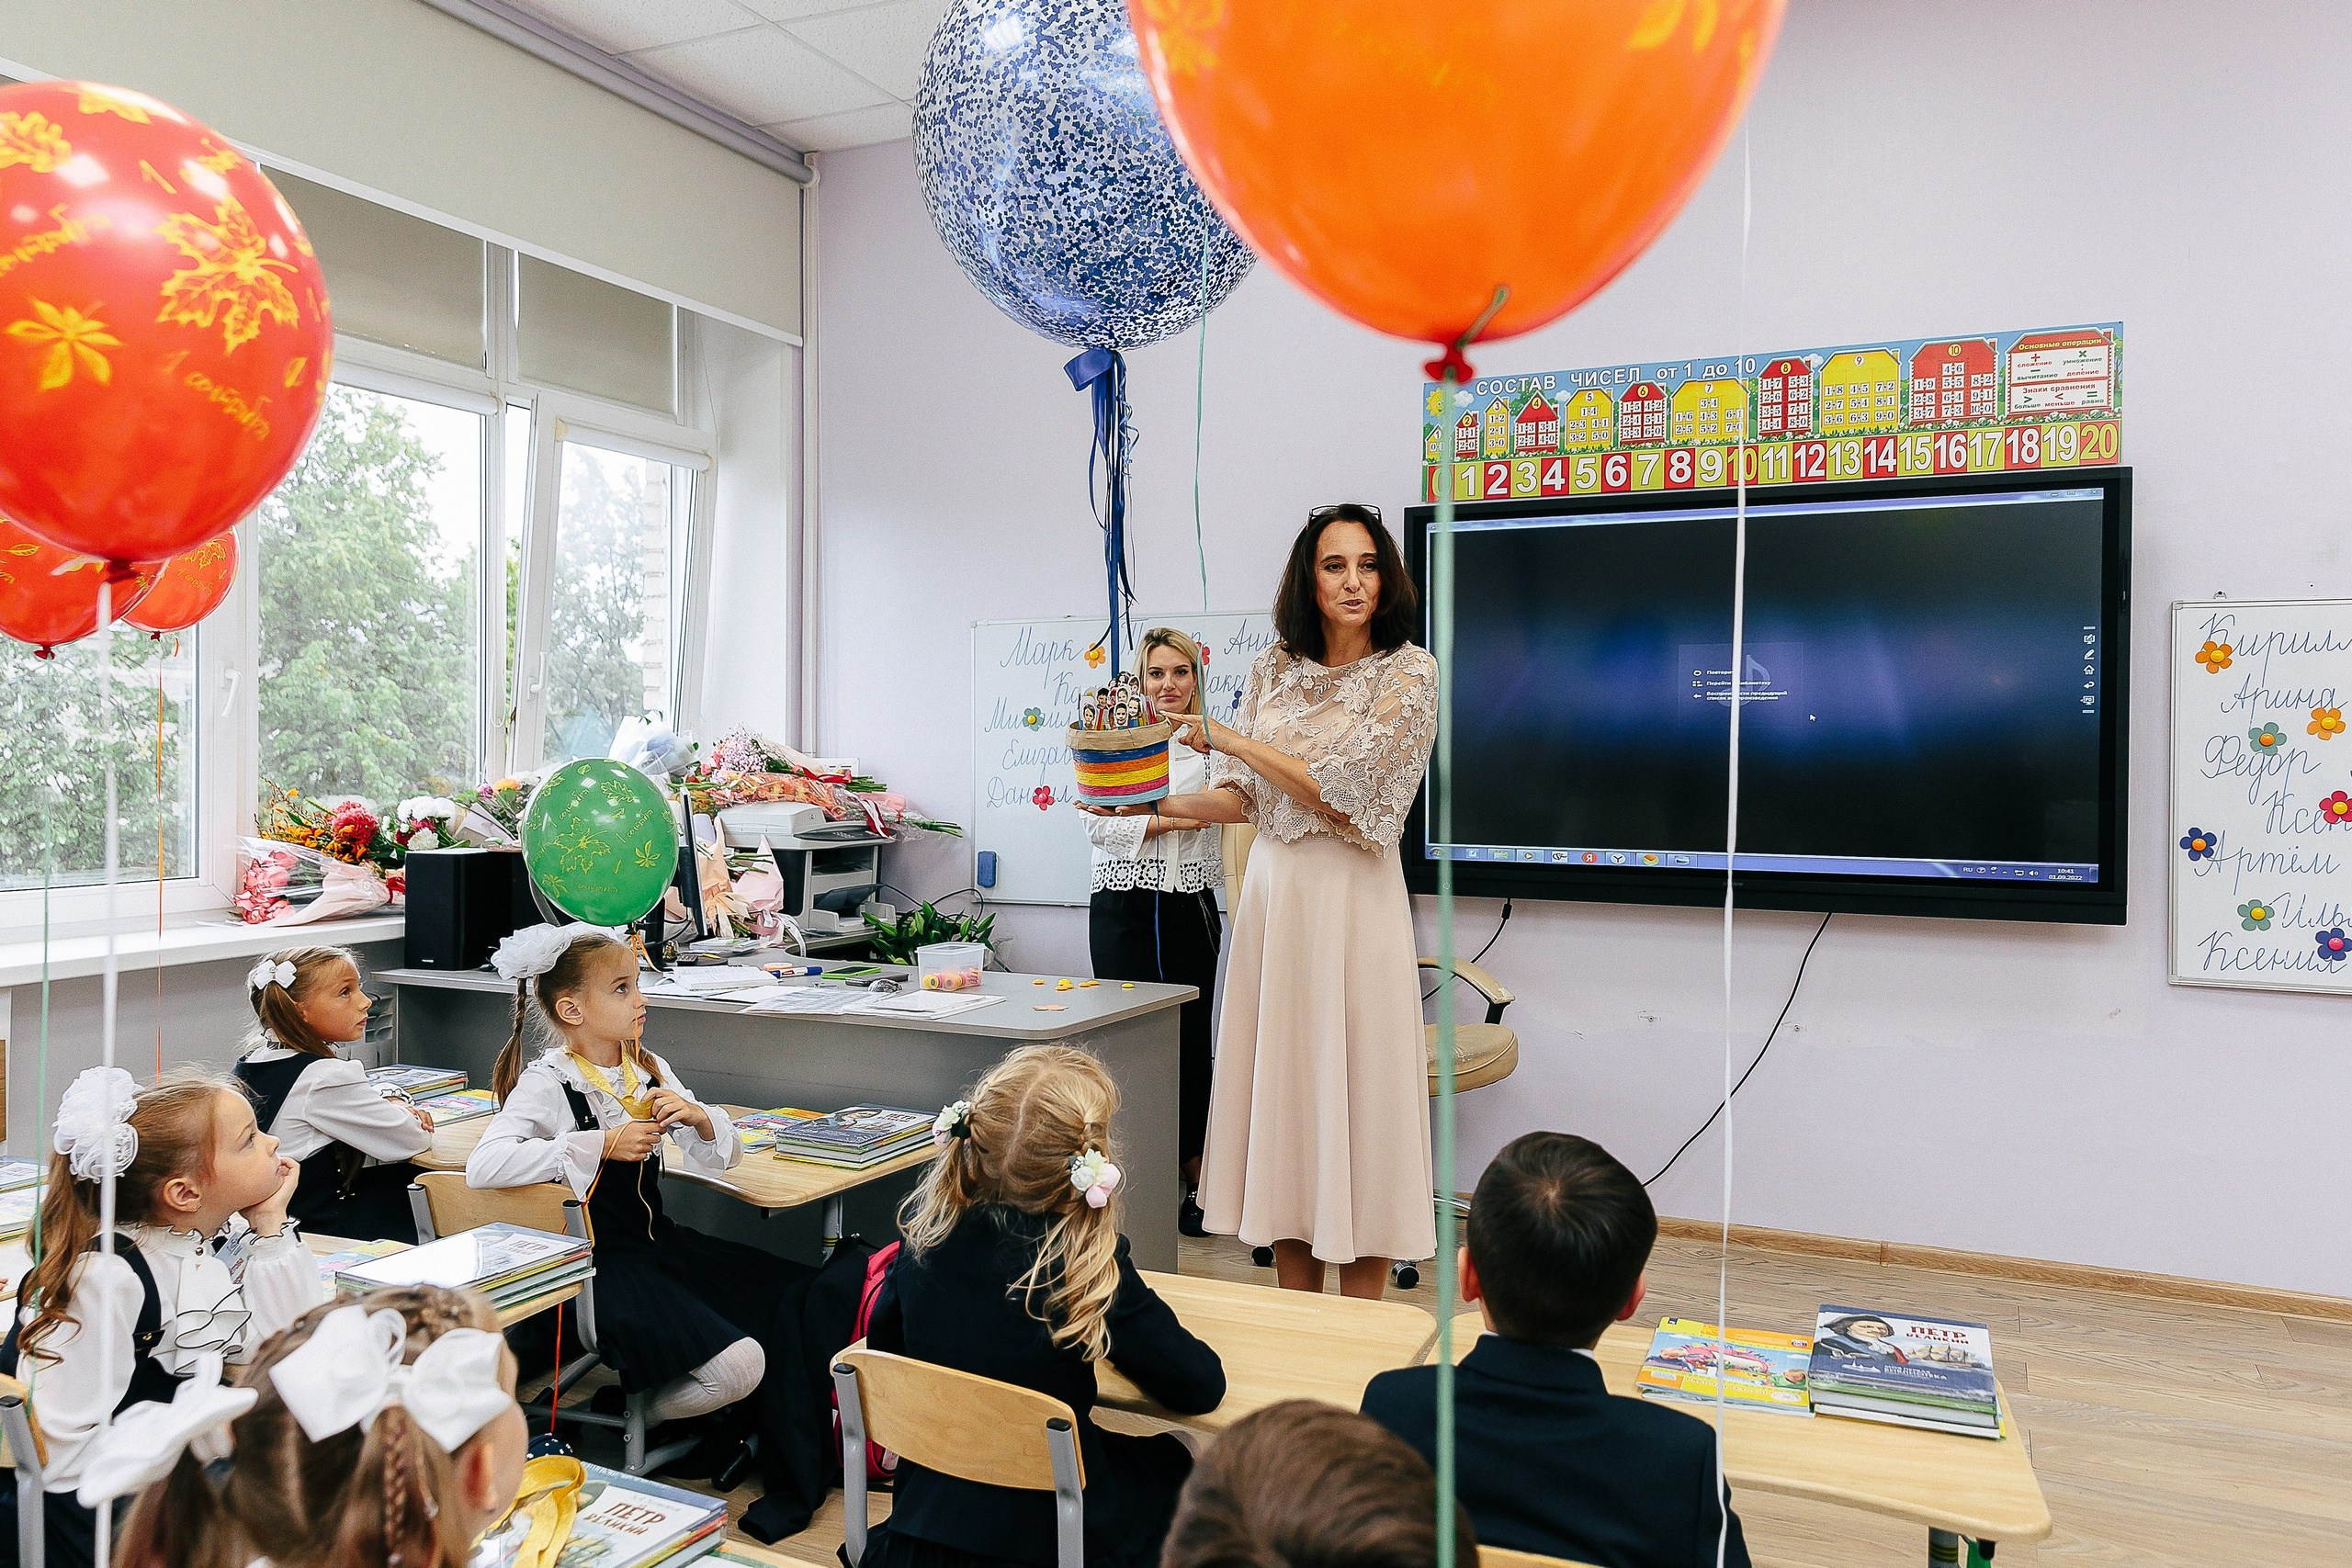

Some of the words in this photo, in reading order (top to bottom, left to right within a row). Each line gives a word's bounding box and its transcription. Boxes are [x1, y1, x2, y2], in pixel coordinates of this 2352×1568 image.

[1951, 345, 1960, 355] 10
[2018, 342, 2060, 350] Основные
[2062, 338, 2102, 347] операции
[1857, 356, 1862, 365] 9
[2017, 360, 2052, 368] сложение
[2063, 356, 2103, 366] умножение
[1782, 364, 1789, 373] 8
[1476, 375, 1557, 396] СОСТАВ
[1570, 367, 1641, 387] ЧИСЕЛ
[1657, 367, 1678, 380] от
[1683, 362, 1692, 378] 1
[1702, 363, 1728, 380] до
[1734, 357, 1757, 375] 10
[2017, 373, 2058, 381] вычитание
[2066, 369, 2099, 378] деление
[1640, 387, 1645, 396] 6
[1706, 384, 1712, 393] 7
[2050, 384, 2096, 393] сравнения
[1533, 398, 1539, 407] 4
[1587, 393, 1592, 401] 5
[1495, 401, 1499, 412] 3
[1464, 417, 1470, 426] 2
[1431, 467, 1452, 499] 0
[1461, 466, 1476, 496] 1
[1487, 464, 1508, 495] 2
[1516, 461, 1537, 492] 3
[1543, 459, 1565, 491] 4
[1575, 457, 1598, 489] 5
[1605, 455, 1628, 487] 6
[1637, 454, 1660, 486] 7
[1669, 450, 1691, 483] 8
[1700, 449, 1724, 482] 9
[1727, 448, 1758, 481] 10
[1762, 446, 1788, 479] 11
[1794, 443, 1826, 478] 12
[1829, 441, 1861, 475] 13
[1864, 438, 1896, 474] 14
[1899, 436, 1932, 470] 15
[1934, 434, 1967, 469] 16
[1969, 432, 2003, 467] 17
[2006, 428, 2040, 464] 18
[2042, 425, 2078, 461] 19
[2080, 423, 2119, 460] 20
[1000, 626, 1084, 689] Марк
[2221, 673, 2348, 730] Арина
[2199, 735, 2322, 805] Федор
[2194, 830, 2341, 896] Артём
[2269, 892, 2352, 928] Иль
[2198, 931, 2348, 974] Ксения
